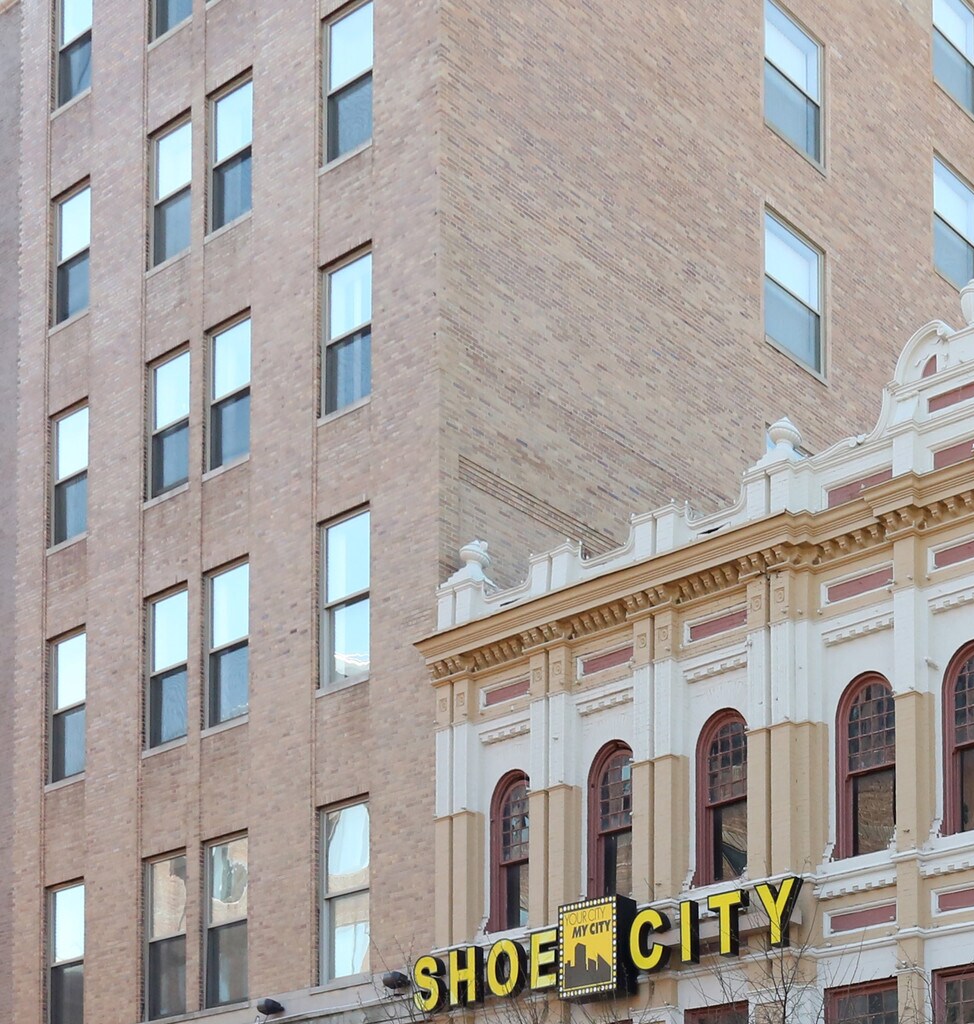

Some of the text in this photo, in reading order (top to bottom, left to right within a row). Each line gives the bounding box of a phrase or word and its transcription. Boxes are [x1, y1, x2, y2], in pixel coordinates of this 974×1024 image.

[564, 907, 606, 926] YOUR CITY
[572, 919, 611, 939] MY CITY
[413, 877, 803, 1013] SHOE CITY
